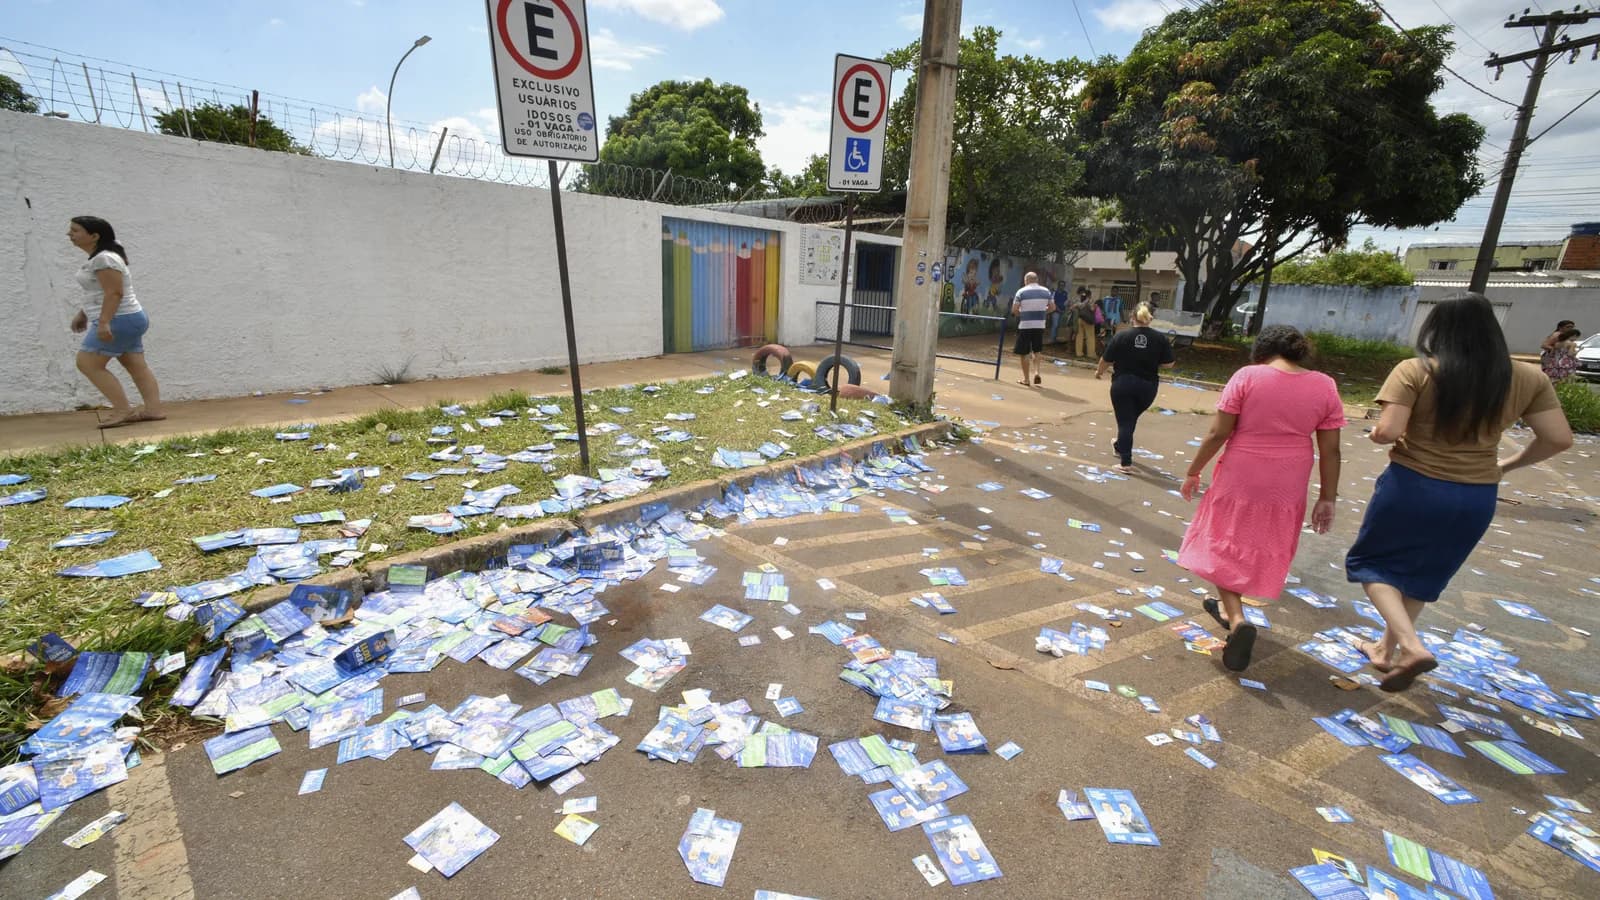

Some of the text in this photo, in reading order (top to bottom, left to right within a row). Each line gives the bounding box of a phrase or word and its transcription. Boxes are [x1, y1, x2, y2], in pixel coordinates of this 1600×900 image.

[524, 2, 558, 60] E
[512, 78, 580, 97] EXCLUSIVO
[853, 78, 872, 118] E
[527, 109, 572, 123] IDOSOS
[514, 127, 532, 136] USO
[528, 120, 540, 129] 01
[544, 122, 574, 133] VAGA
[517, 138, 528, 146] DE
